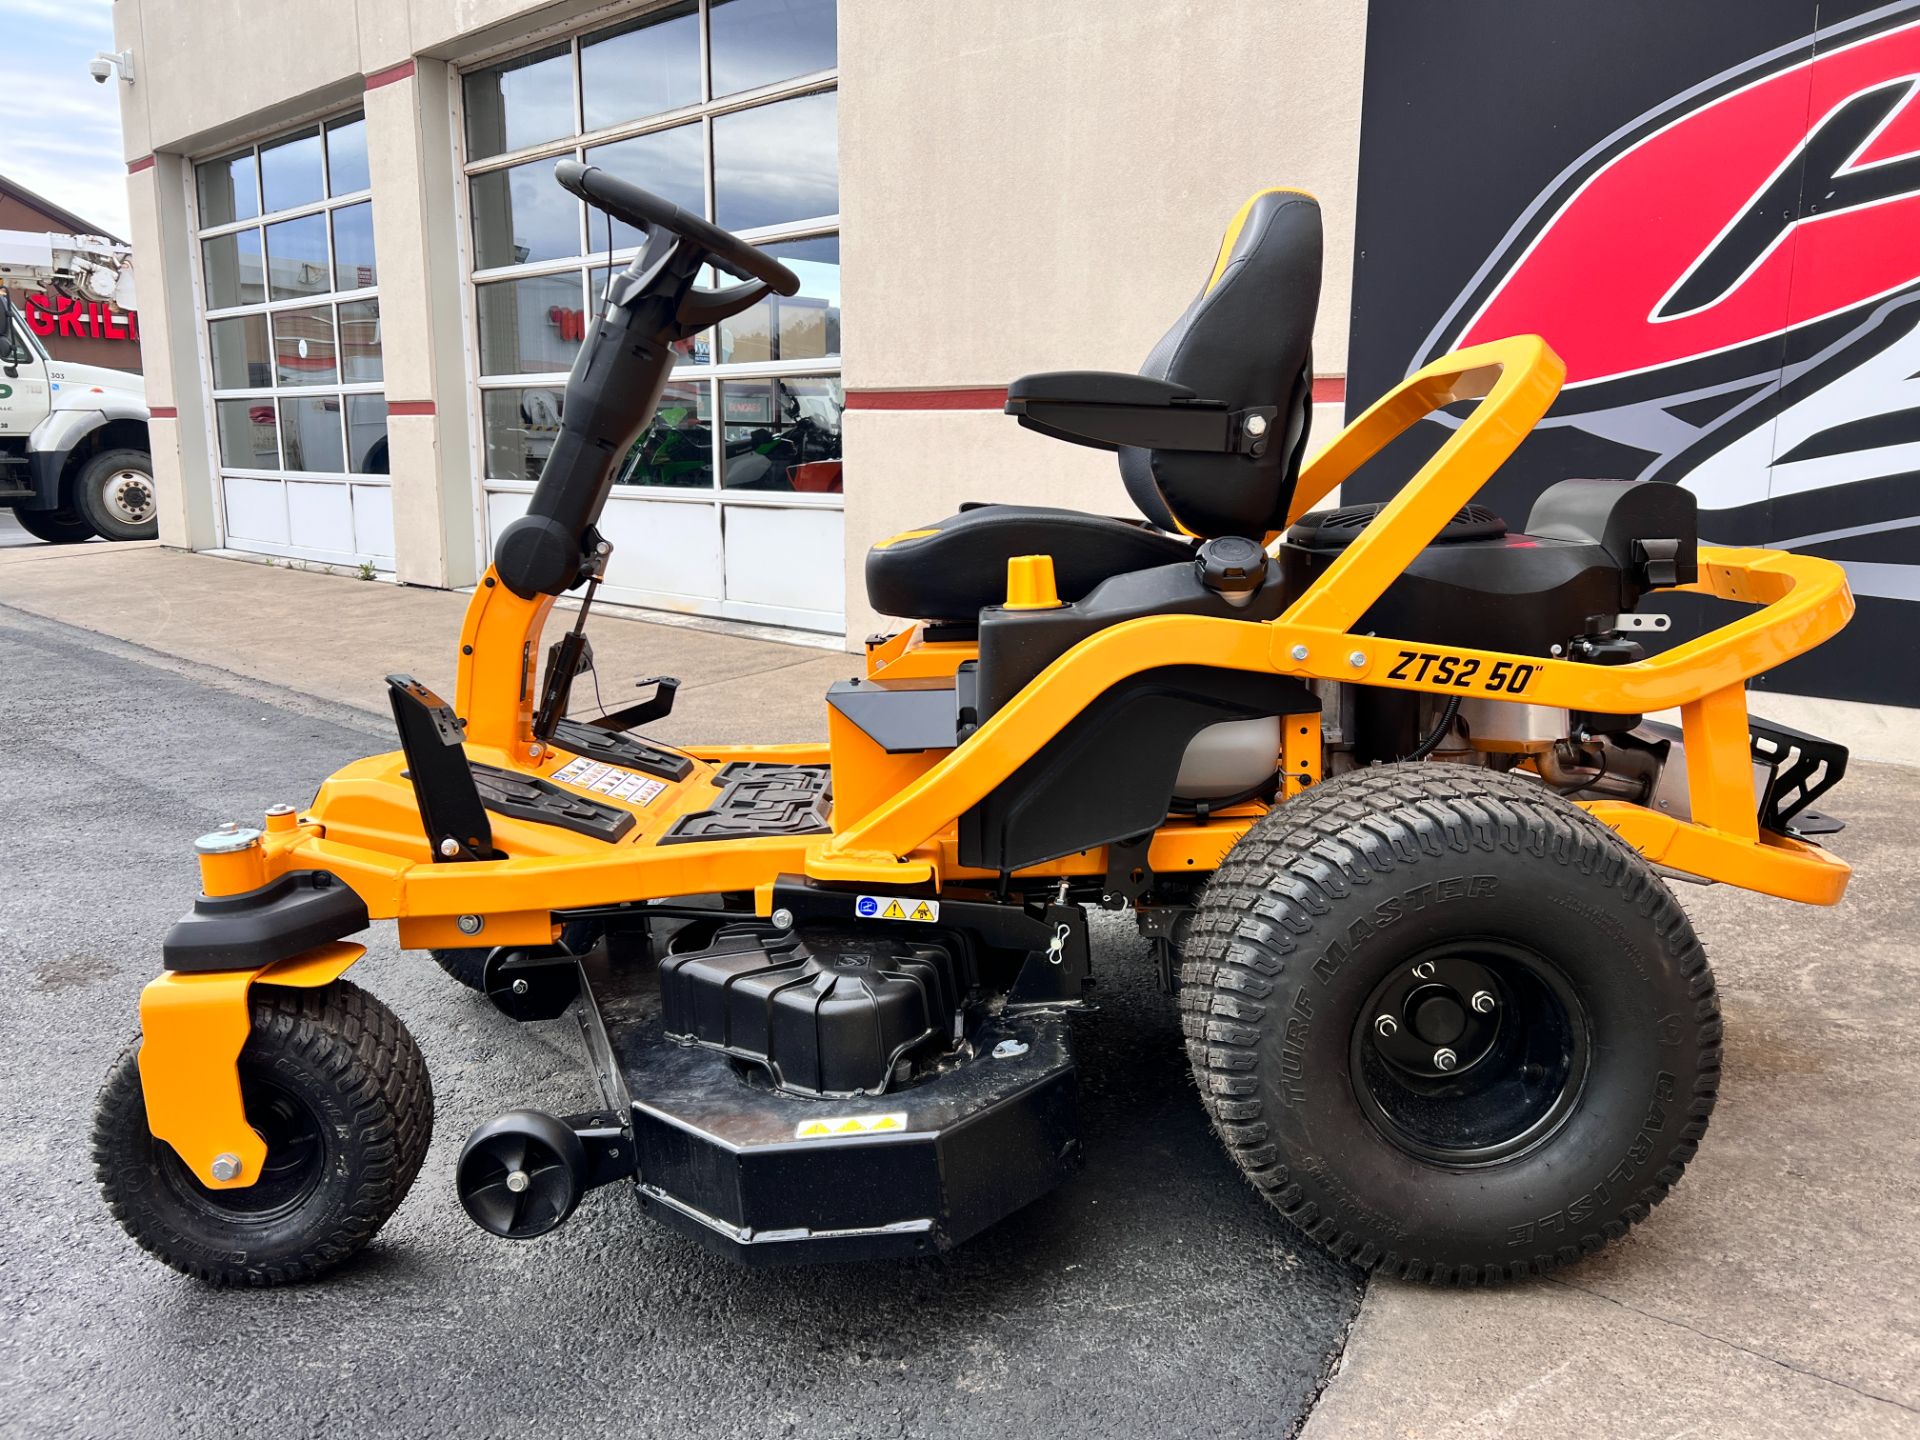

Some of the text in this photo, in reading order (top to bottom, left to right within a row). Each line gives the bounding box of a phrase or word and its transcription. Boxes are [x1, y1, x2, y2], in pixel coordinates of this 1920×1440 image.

[1387, 651, 1544, 694] ZTS2 50"
[1278, 874, 1501, 1108] TURF MASTER
[1506, 1070, 1677, 1247] CARLISLE
